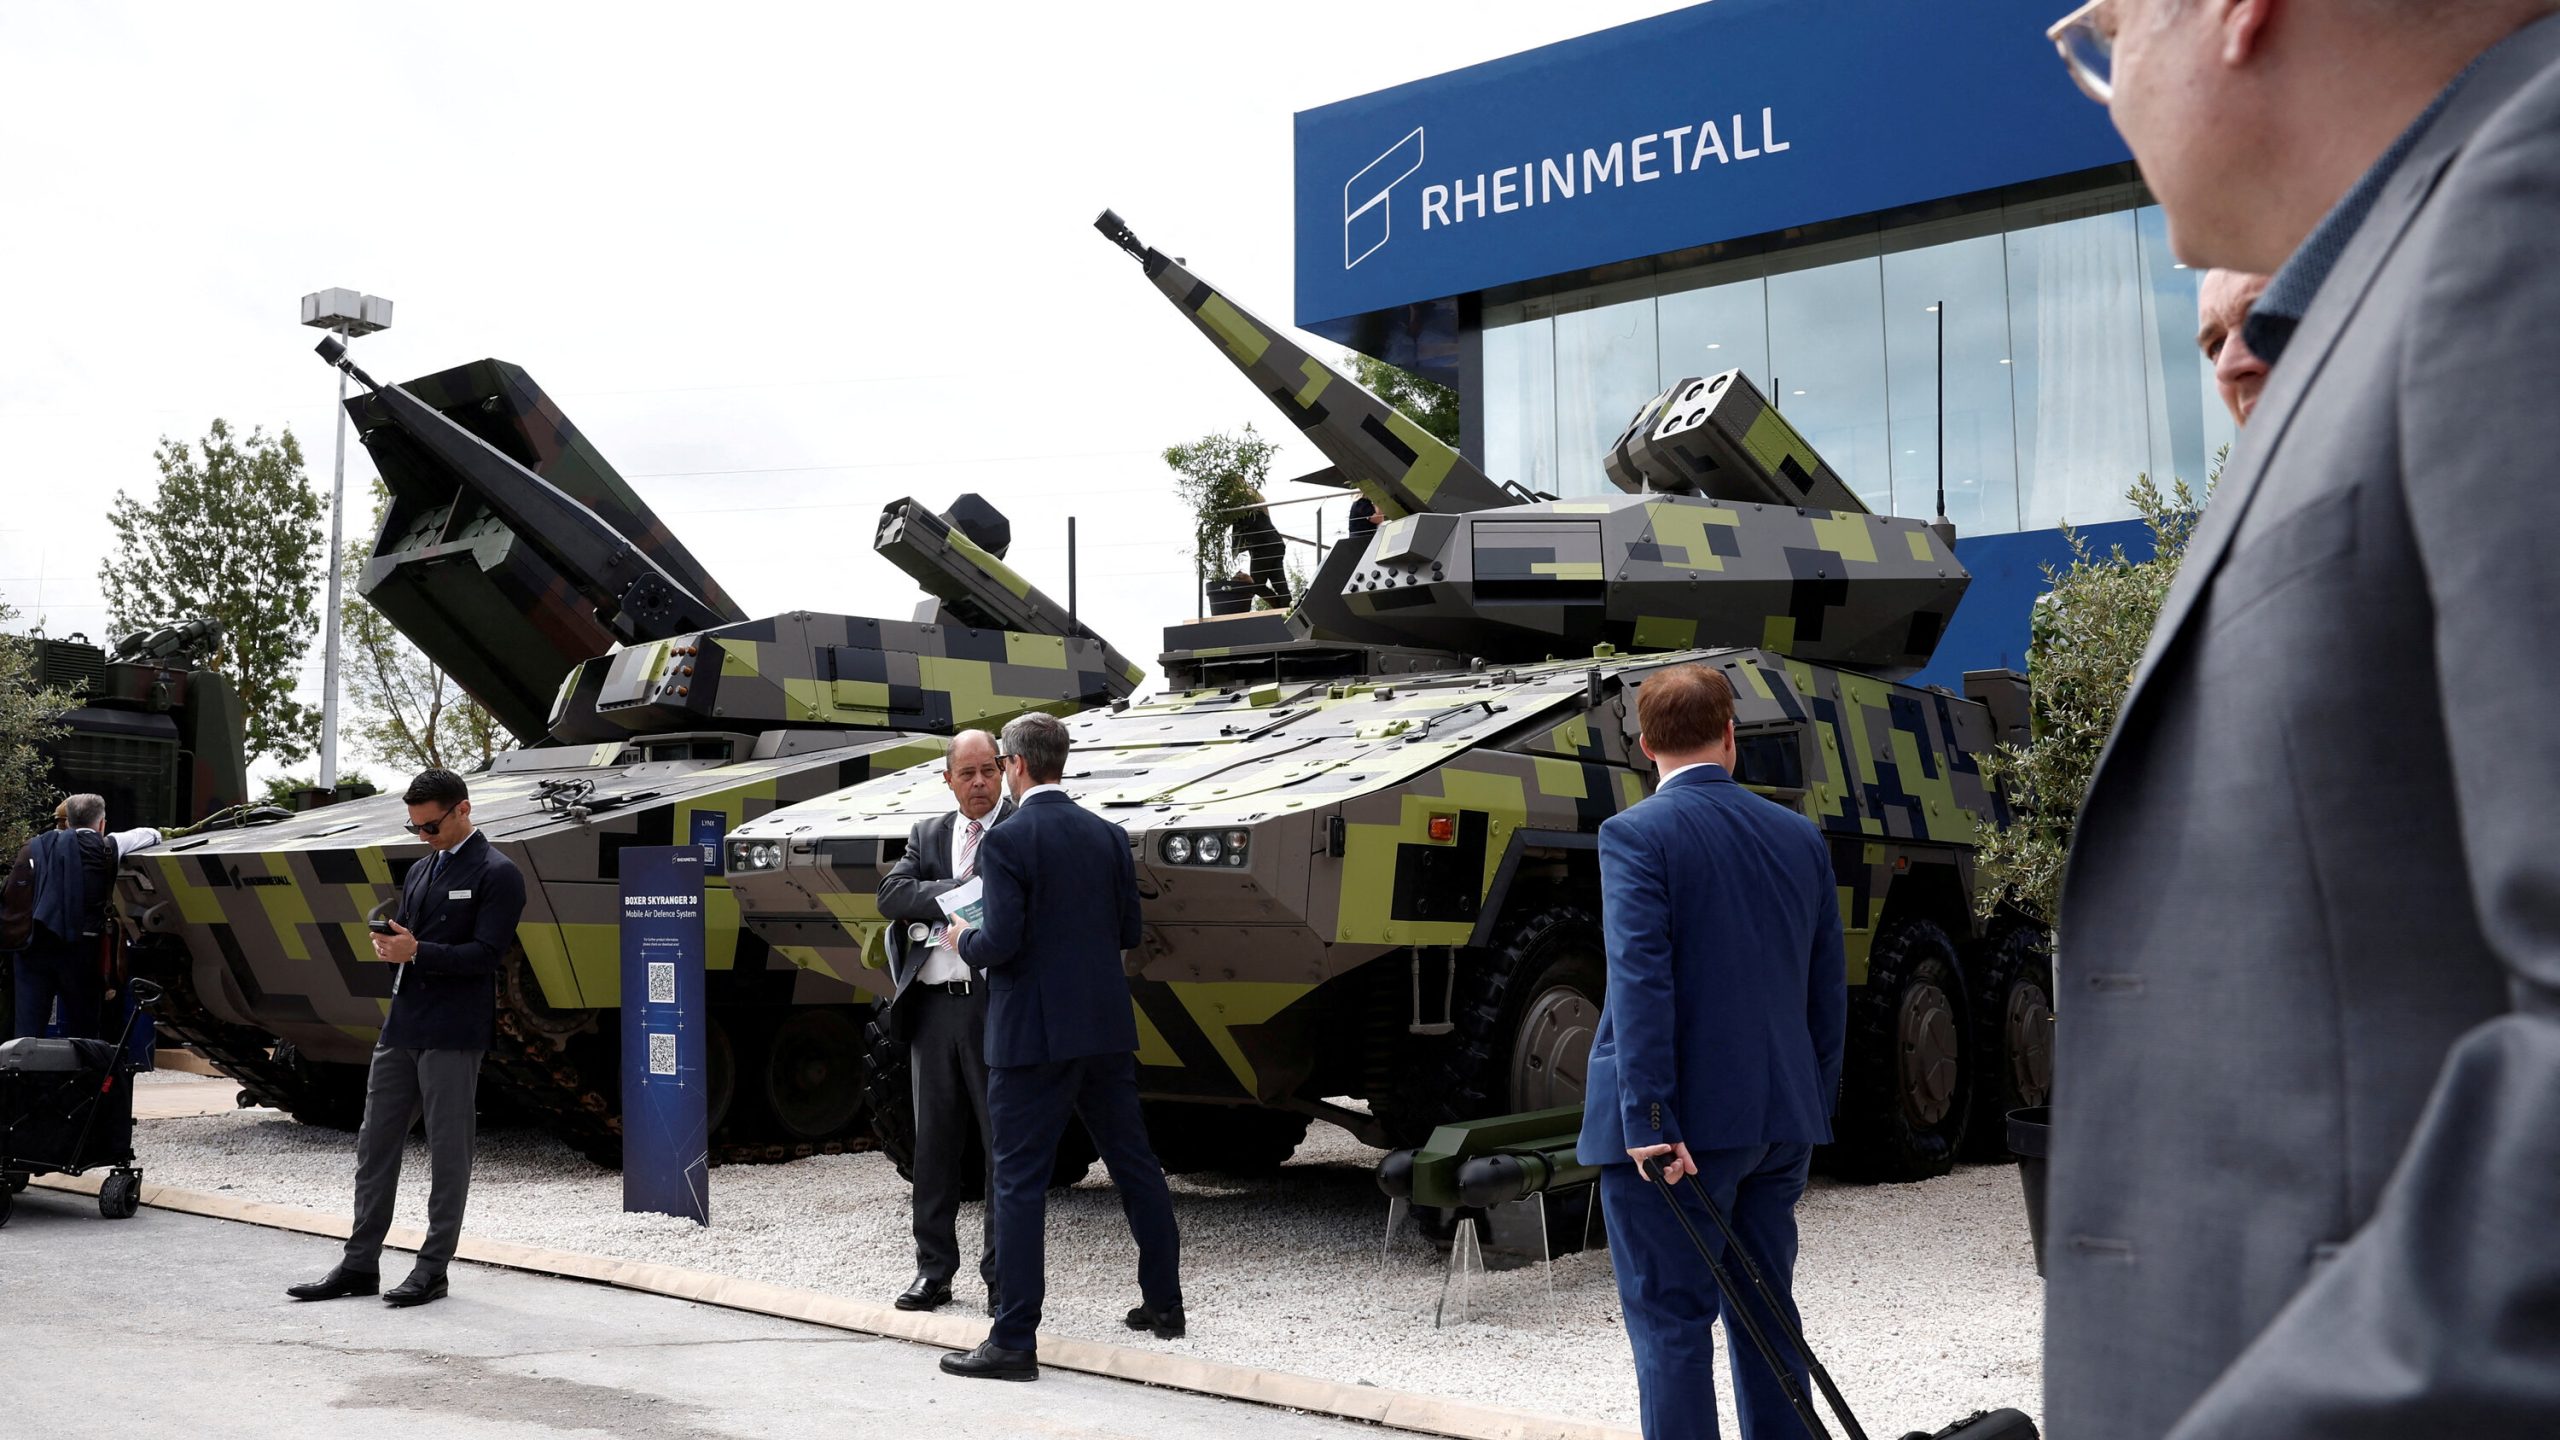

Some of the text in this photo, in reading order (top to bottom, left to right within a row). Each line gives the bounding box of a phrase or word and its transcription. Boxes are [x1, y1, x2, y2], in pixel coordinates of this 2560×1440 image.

[1421, 106, 1790, 230] RHEINMETALL
[701, 819, 715, 827] LYNX
[624, 895, 698, 905] BOXER SKYRANGER 30
[625, 909, 697, 920] Mobile Air Defence System
